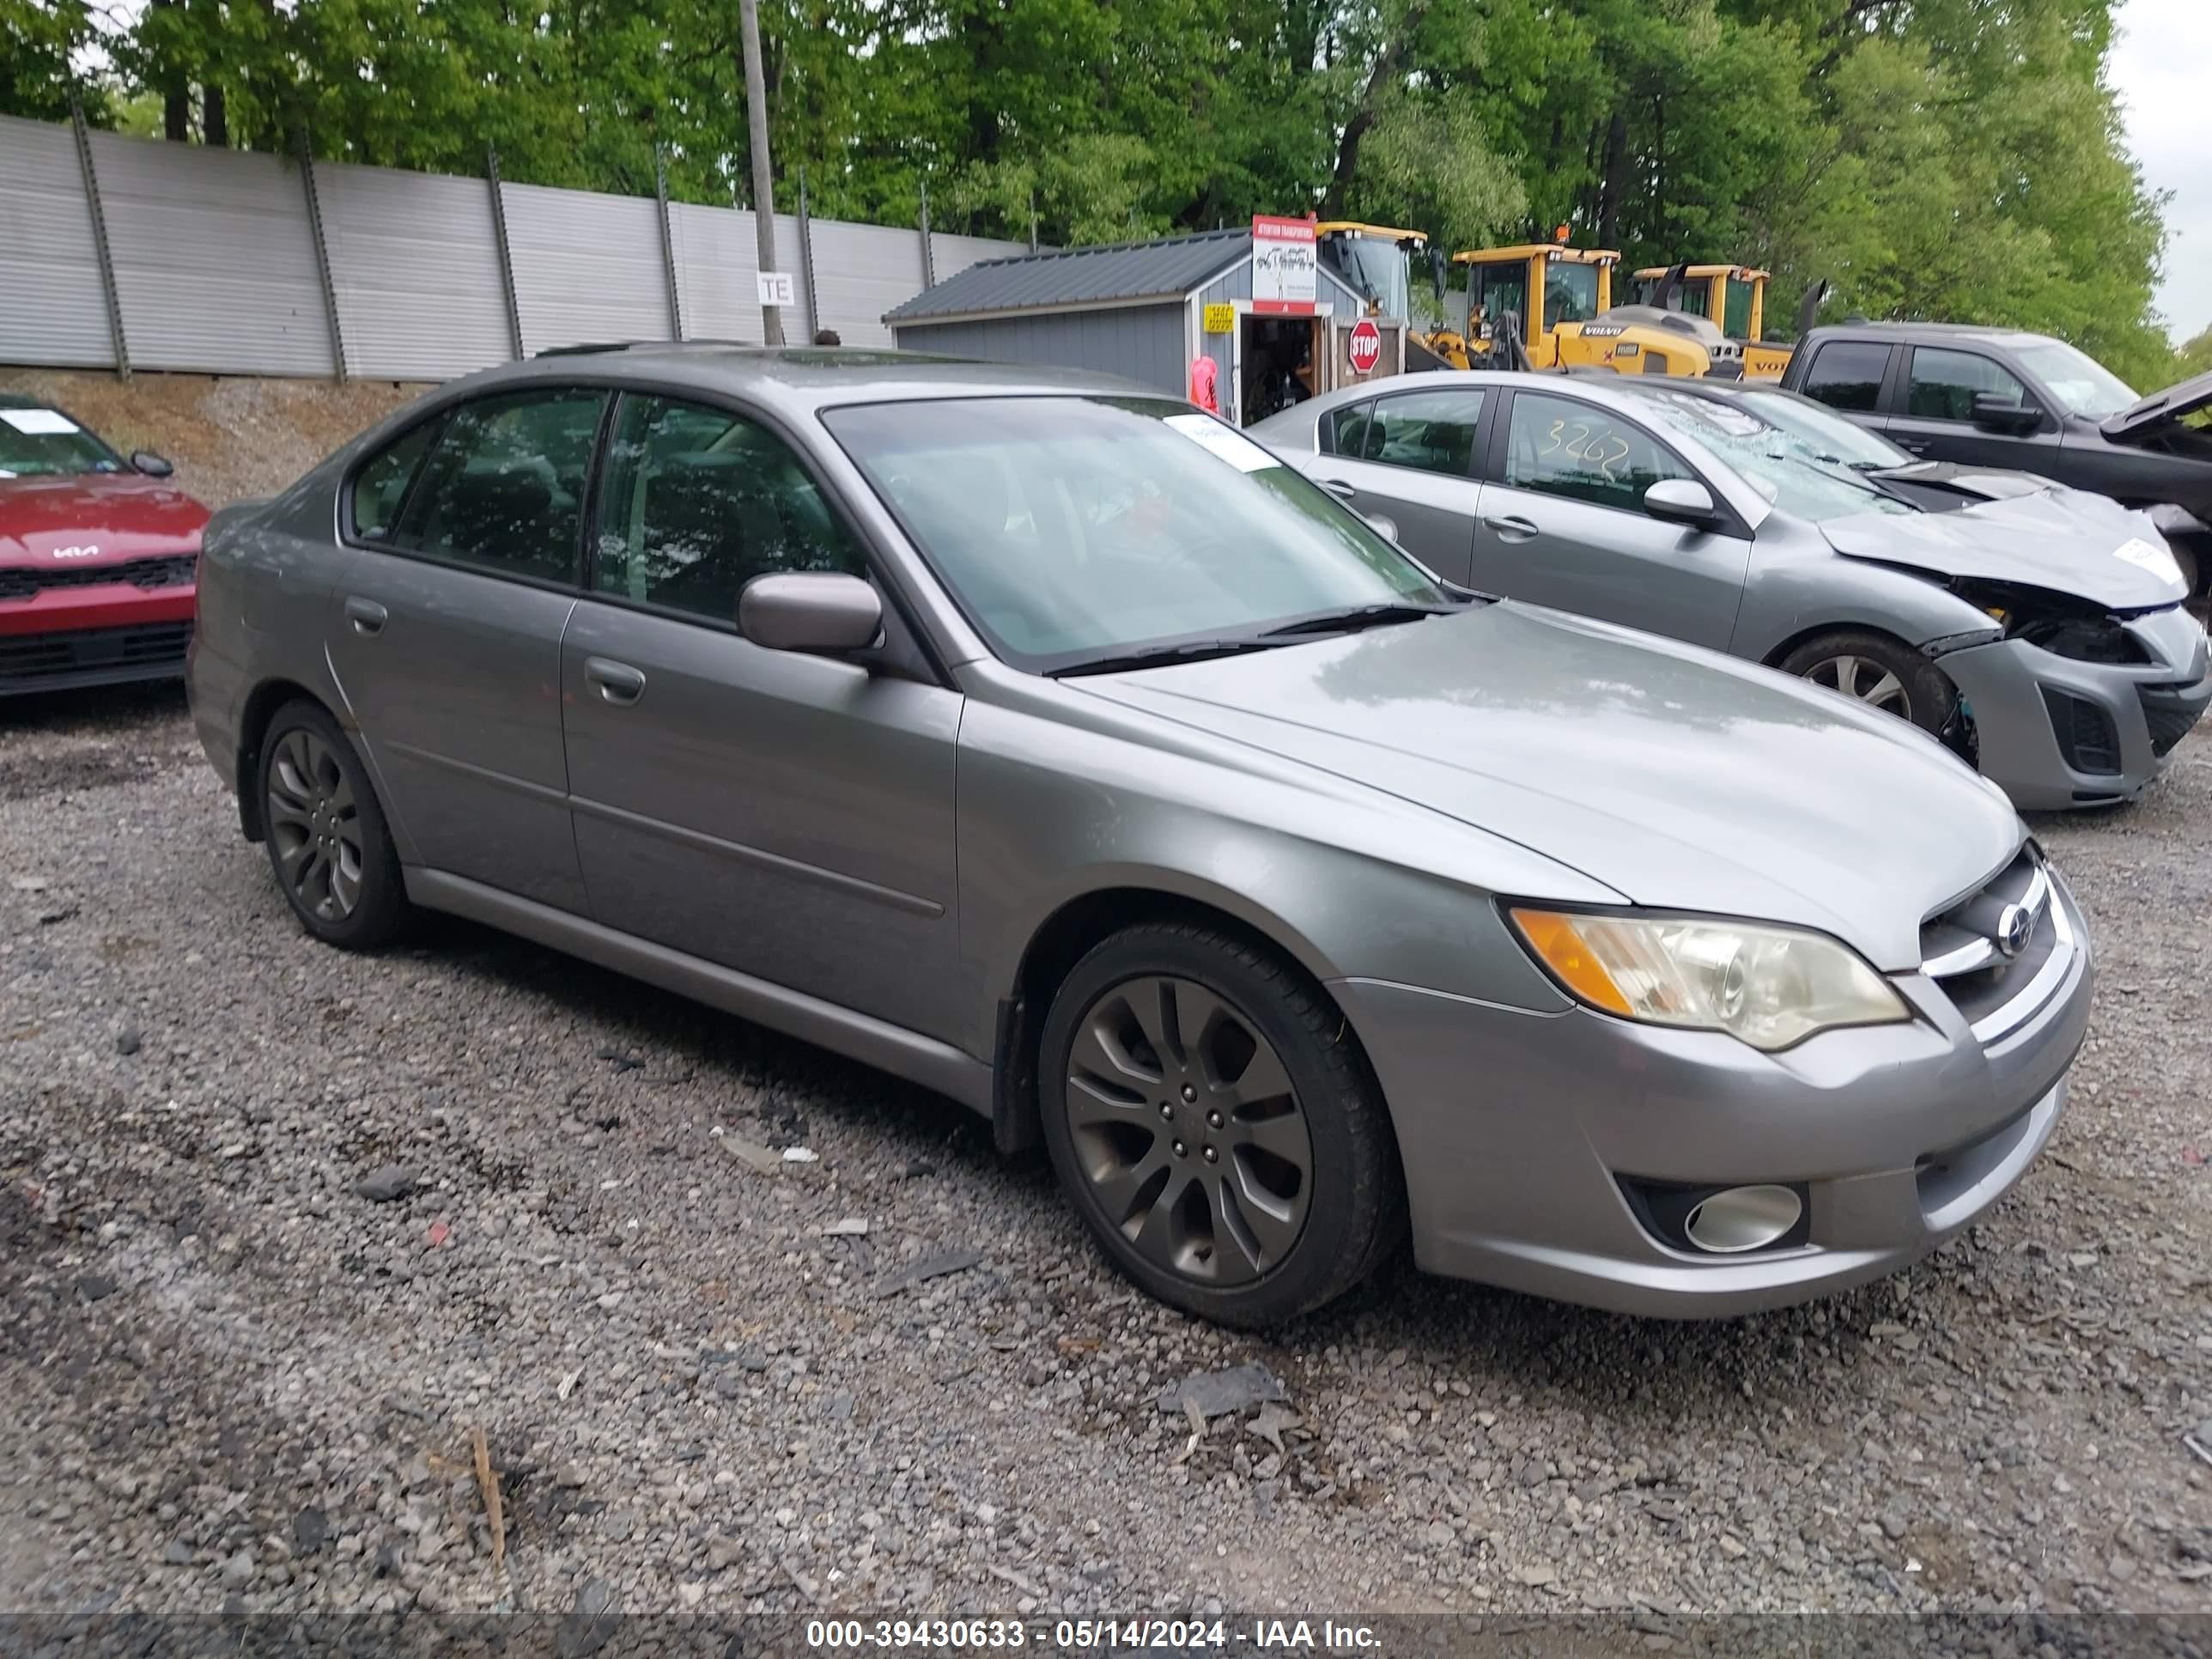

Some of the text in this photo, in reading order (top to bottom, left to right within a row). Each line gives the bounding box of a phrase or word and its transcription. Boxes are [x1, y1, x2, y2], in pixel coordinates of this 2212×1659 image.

[762, 277, 789, 300] TE
[1585, 326, 1622, 335] VOLVO
[1352, 335, 1378, 357] STOP
[1540, 419, 1629, 483] 3262
[53, 545, 99, 558] KIA
